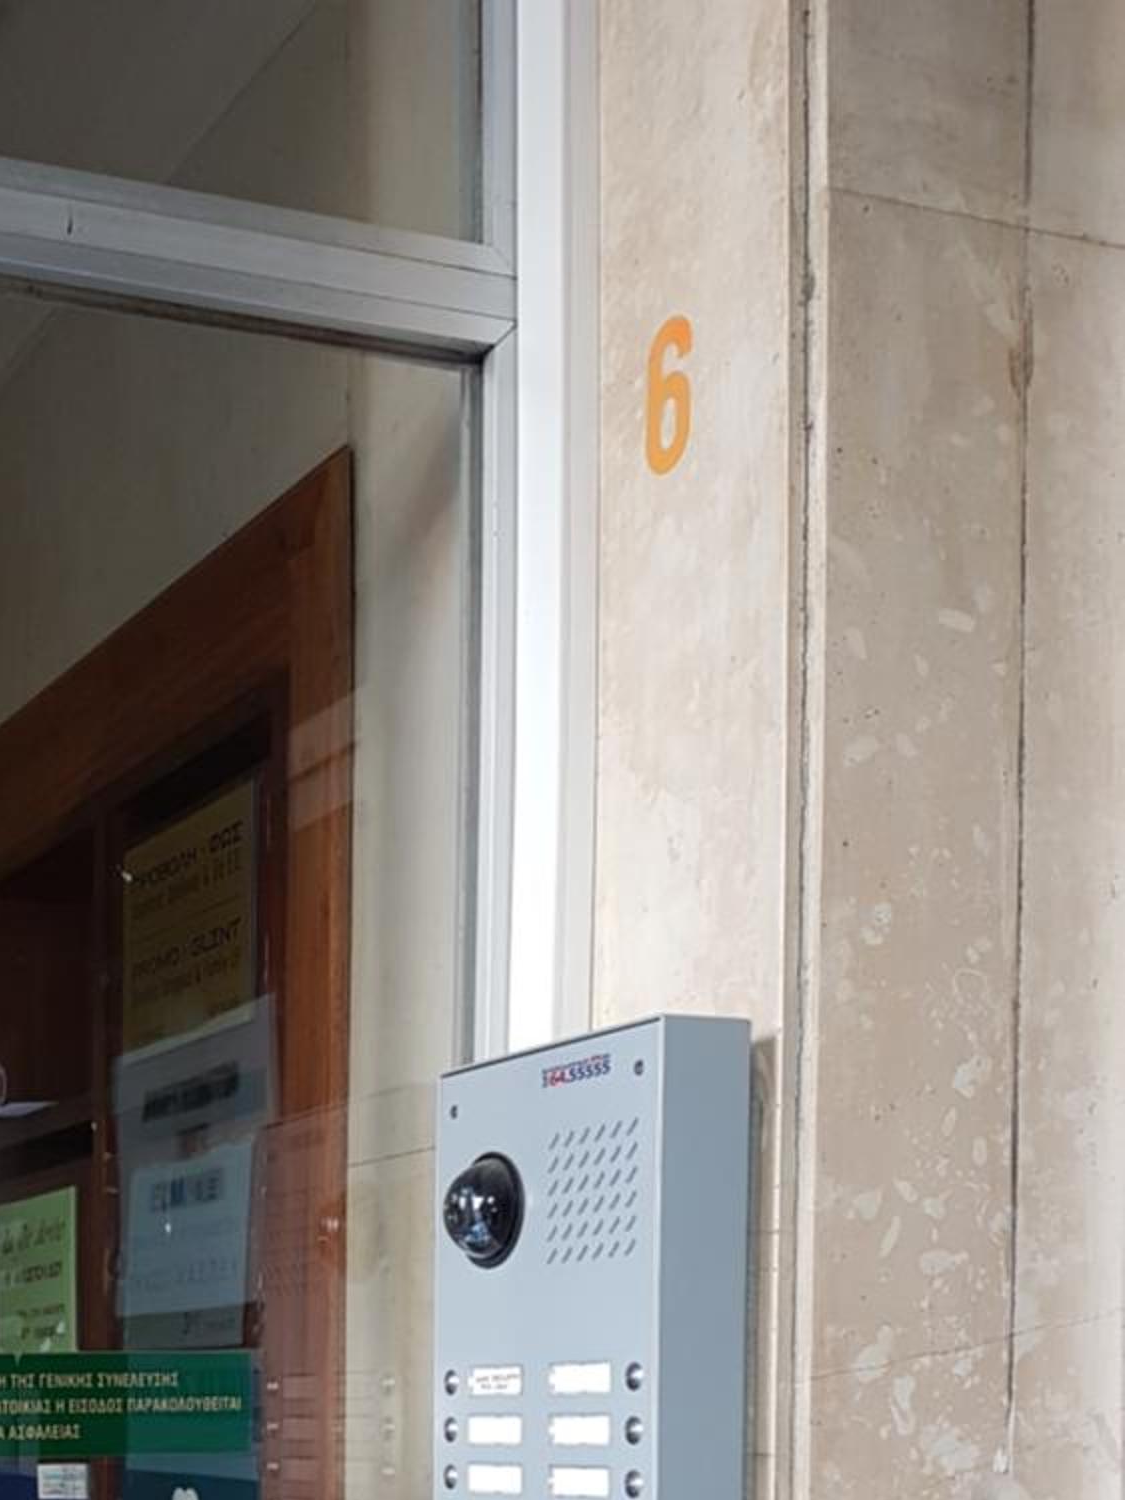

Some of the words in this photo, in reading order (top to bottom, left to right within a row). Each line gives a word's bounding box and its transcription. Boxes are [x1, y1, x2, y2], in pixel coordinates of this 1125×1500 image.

[645, 315, 693, 475] 6
[10, 1373, 35, 1389] ΤΗΣ
[38, 1373, 93, 1389] ΓΕΝΙΚΗΣ
[97, 1371, 179, 1388] ΣΥΝΕΛΕΥΣΗΣ
[68, 1398, 123, 1414] ΕΙΣΟΔΟΣ
[8, 1424, 81, 1440] ΑΣΦΑΛΕΙΑΣ
